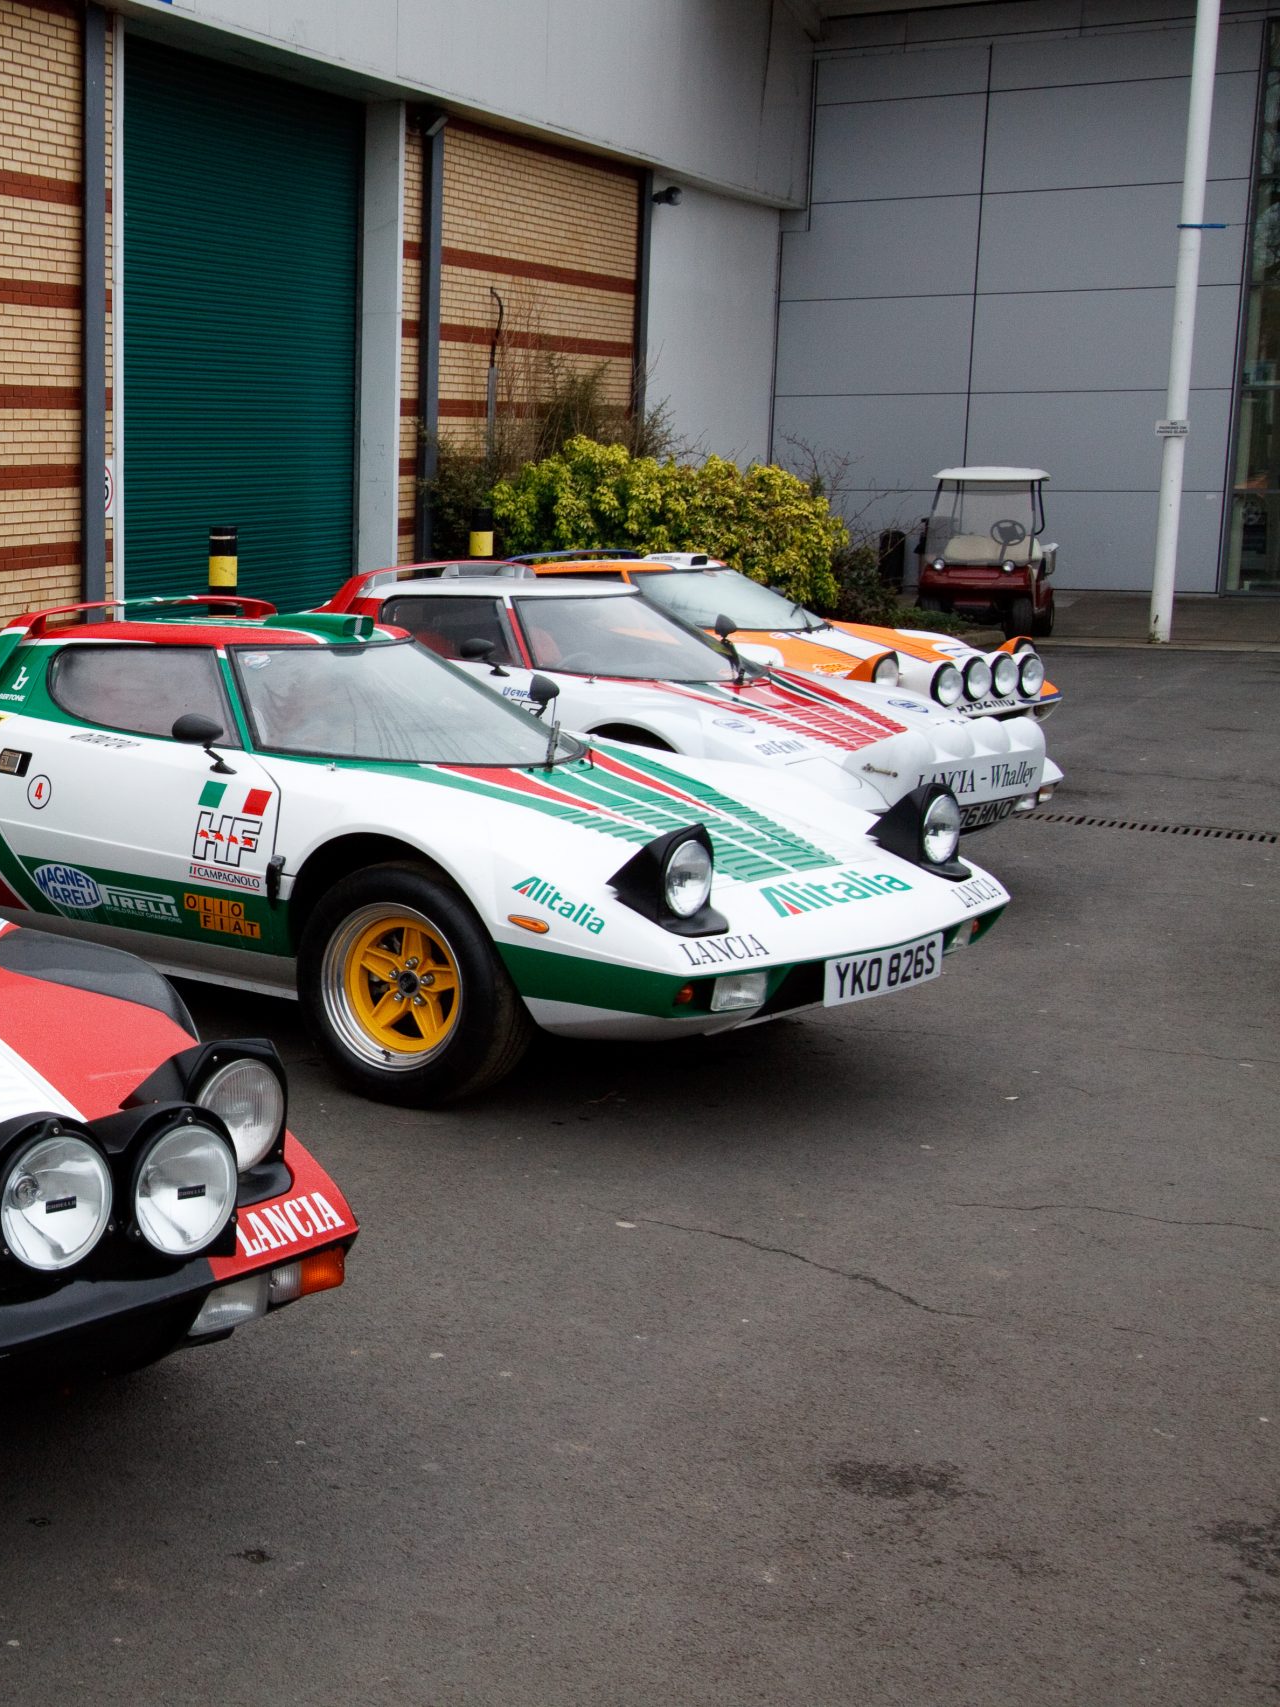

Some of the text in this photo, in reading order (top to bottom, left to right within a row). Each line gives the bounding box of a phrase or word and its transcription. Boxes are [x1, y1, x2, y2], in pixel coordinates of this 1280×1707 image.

[34, 782, 44, 800] 4
[991, 761, 1038, 788] Whalley
[192, 810, 263, 868] HF
[197, 867, 260, 889] CAMPAGNOLO
[758, 870, 913, 918] Alitalia
[949, 878, 1002, 911] LANCIA
[97, 883, 179, 917] PIRELLI
[186, 894, 243, 917] OLIO
[511, 875, 606, 935] Alitalia
[202, 915, 258, 937] FIAT
[677, 933, 771, 967] LANCIA
[835, 940, 936, 999] YKO 826S
[236, 1191, 345, 1258] LANCIA
